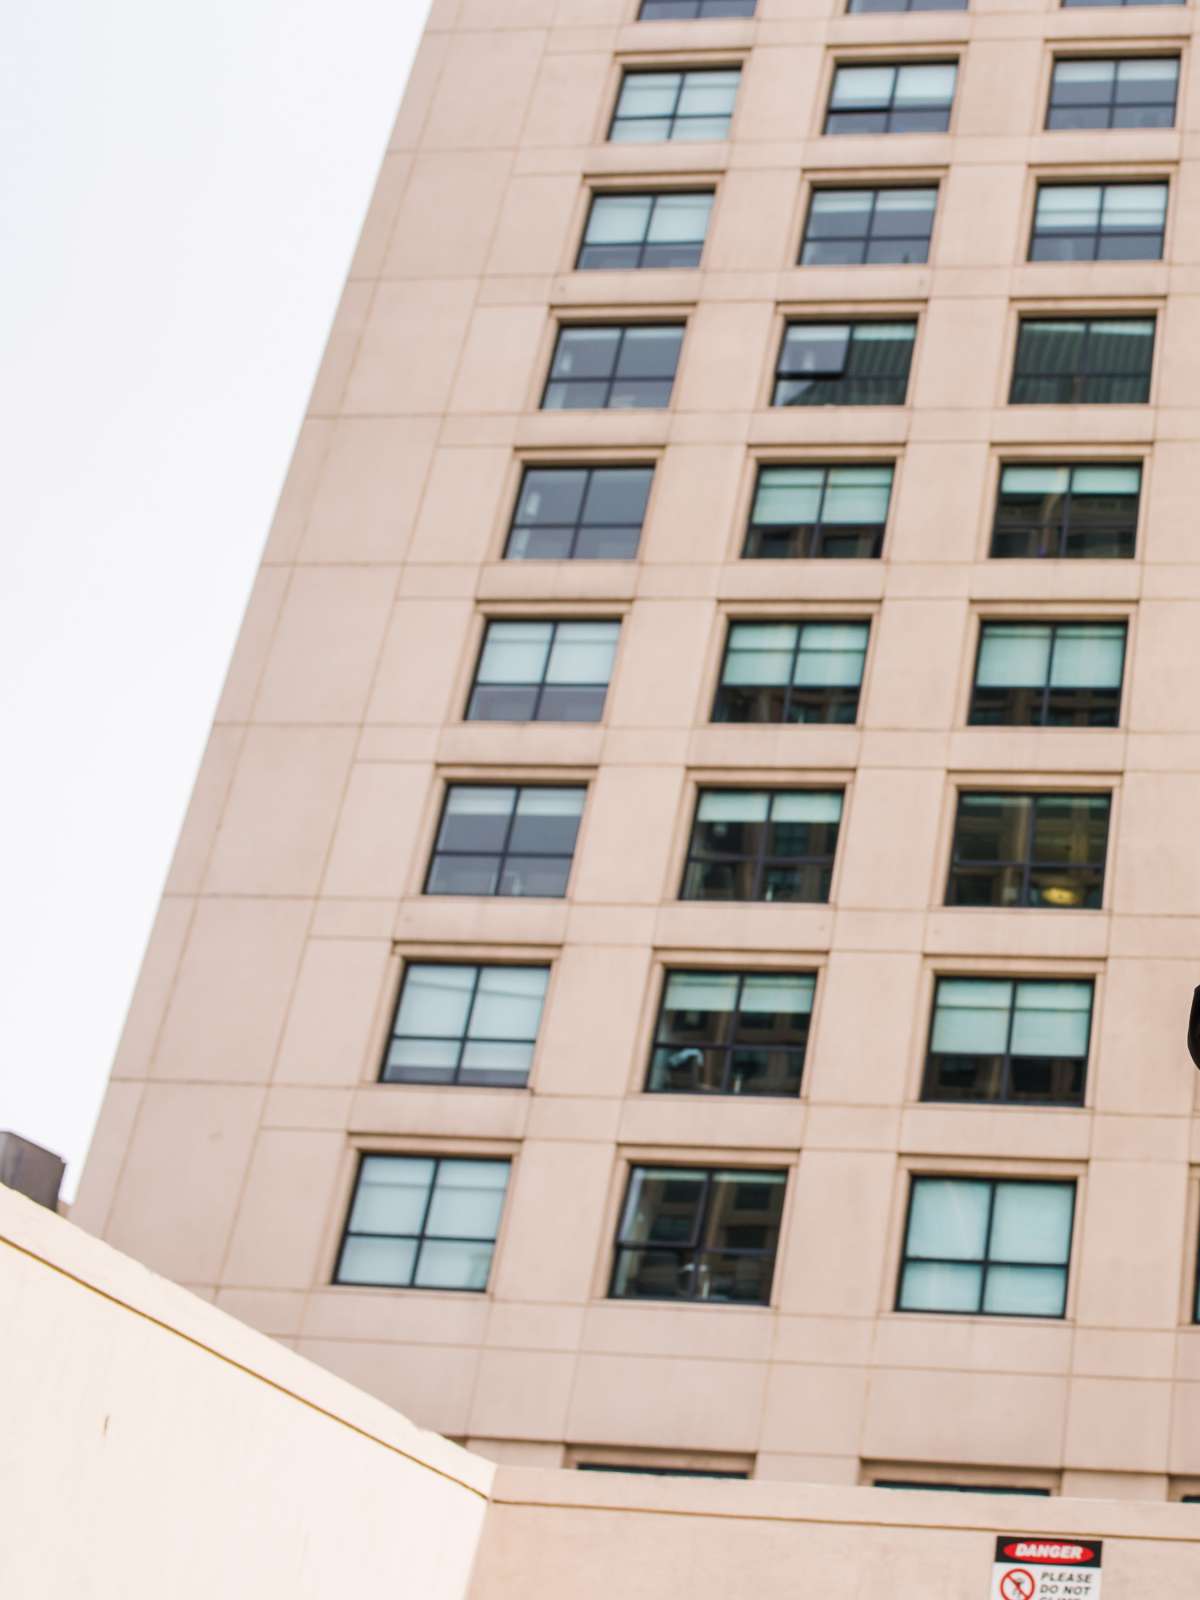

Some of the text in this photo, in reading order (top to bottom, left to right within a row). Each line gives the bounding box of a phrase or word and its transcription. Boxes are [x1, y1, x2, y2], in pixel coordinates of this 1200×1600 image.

[1015, 1543, 1083, 1560] DANGER
[1041, 1572, 1092, 1583] PLEASE
[1040, 1584, 1091, 1596] DO NOT
